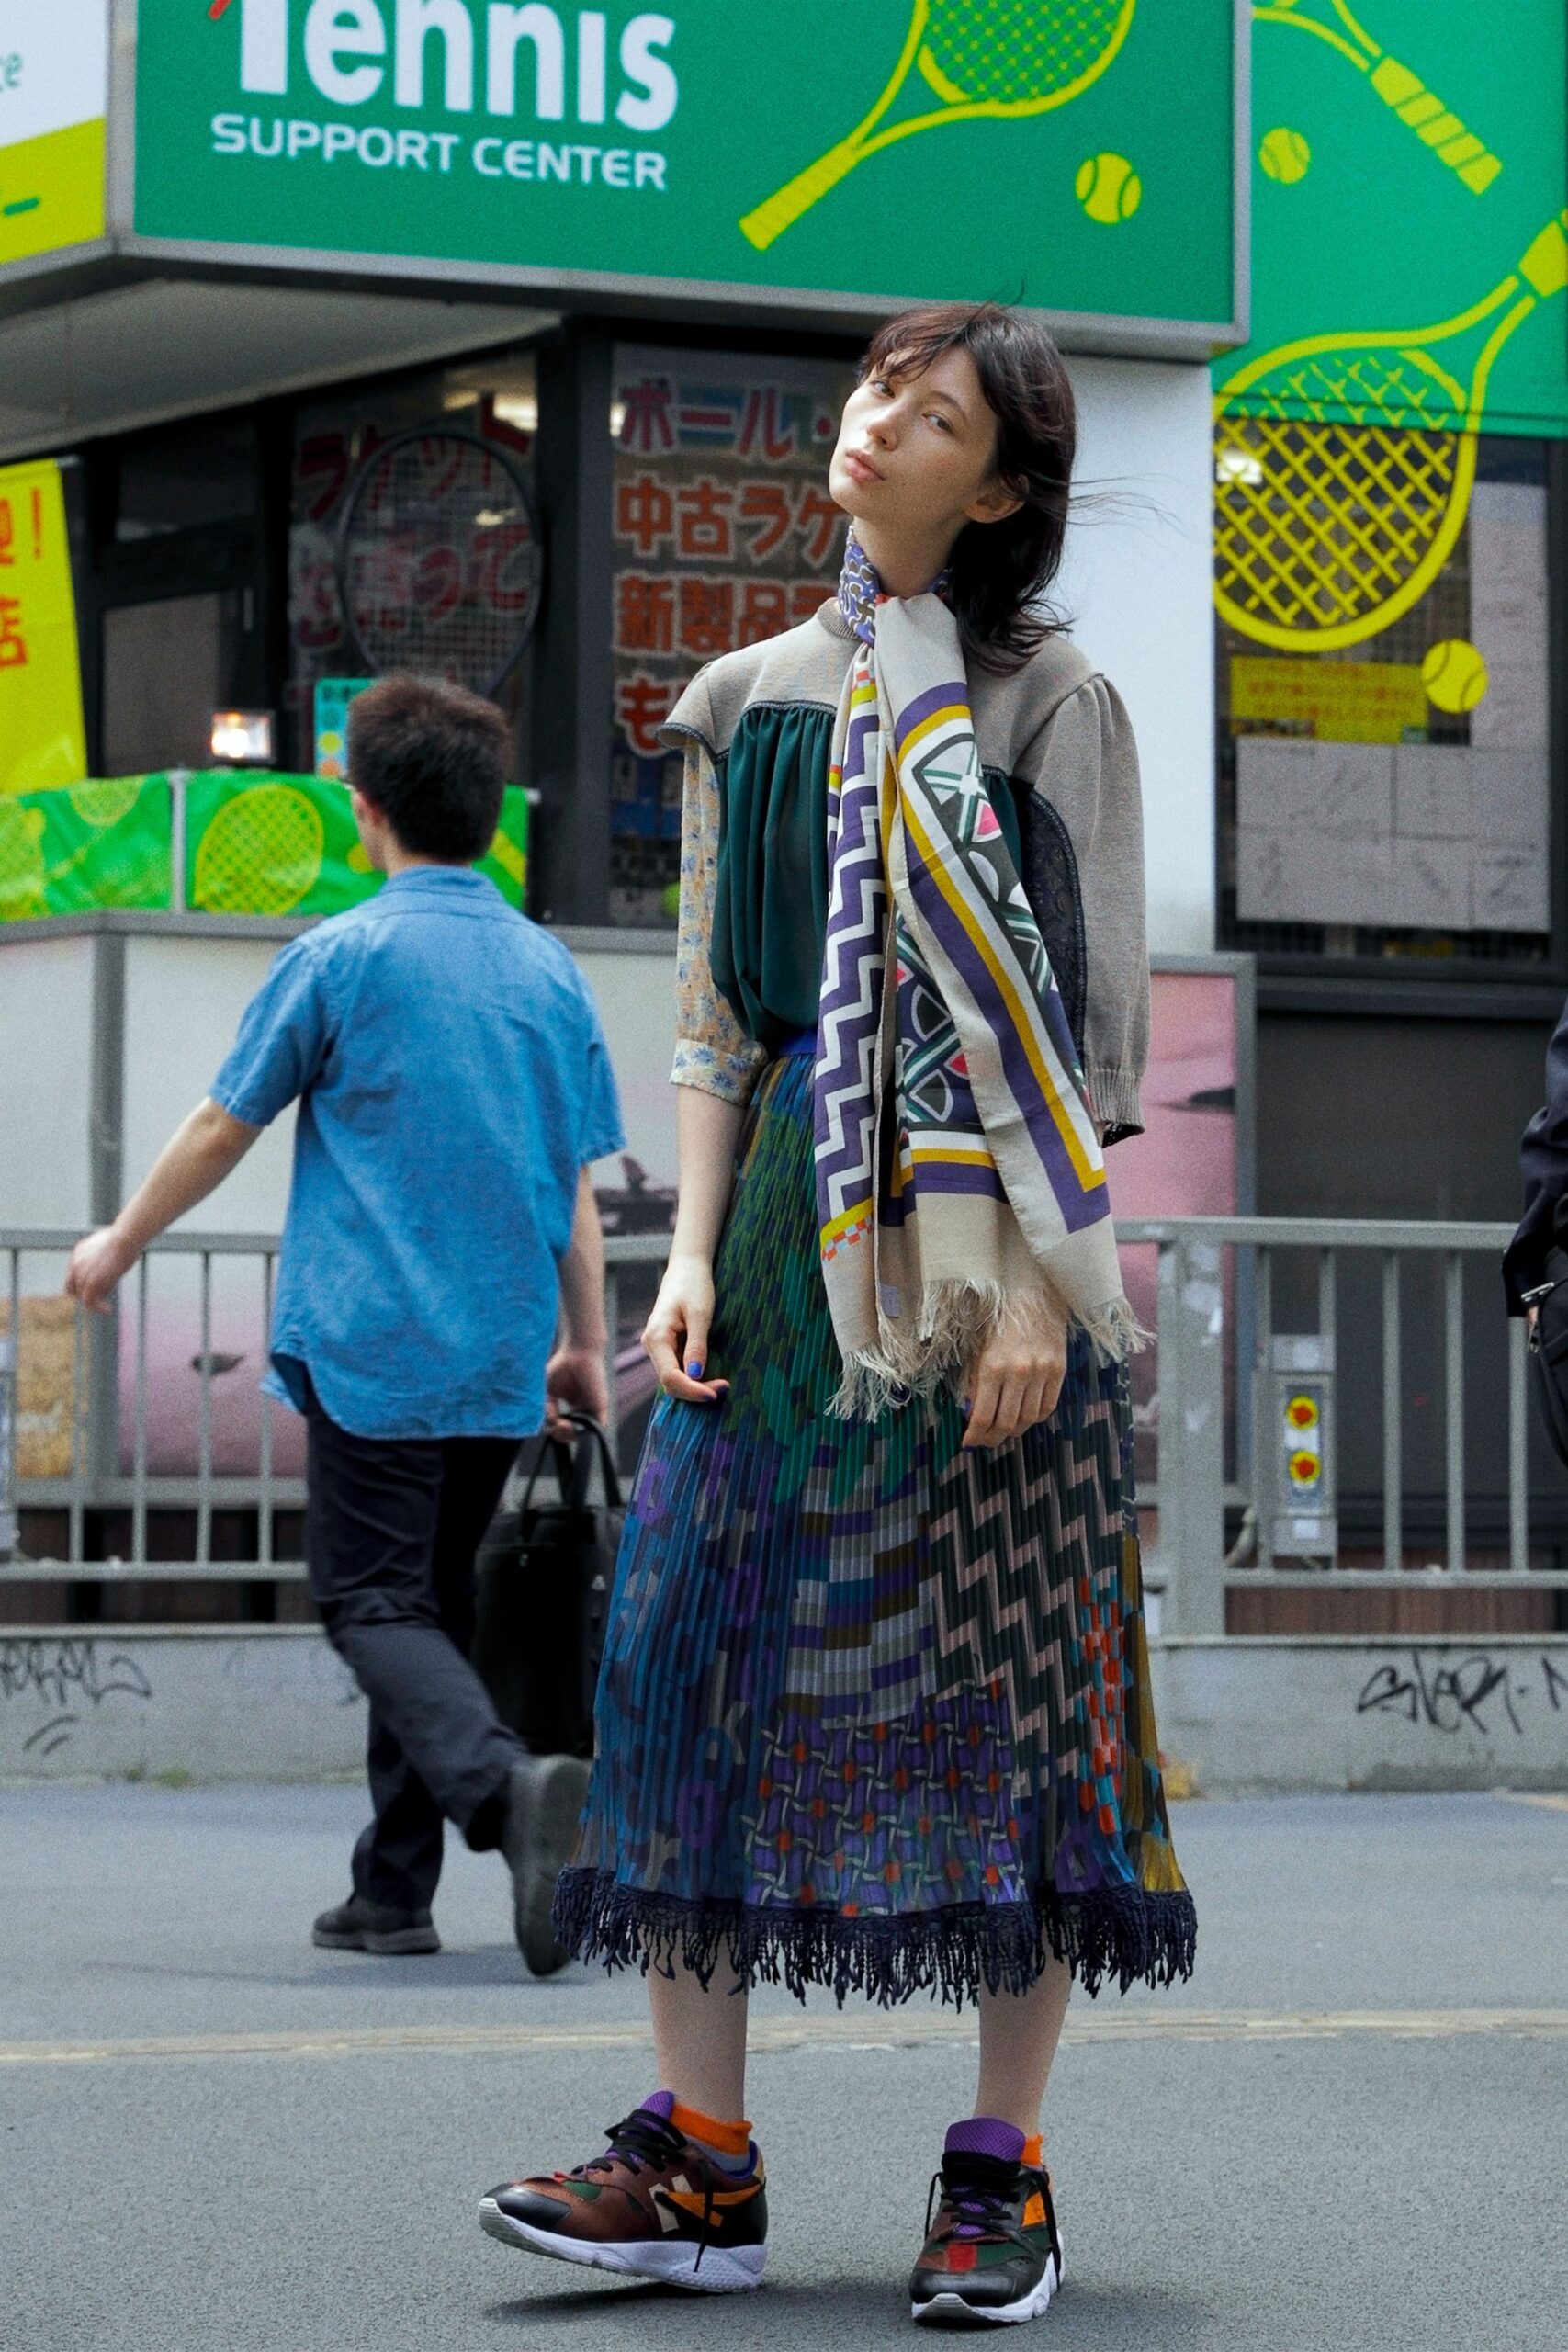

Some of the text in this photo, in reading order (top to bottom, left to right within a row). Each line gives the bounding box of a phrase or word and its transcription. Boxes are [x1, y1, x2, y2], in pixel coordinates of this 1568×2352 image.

[210, 113, 667, 191] SUPPORT CENTER
[620, 575, 840, 652] 新製品
